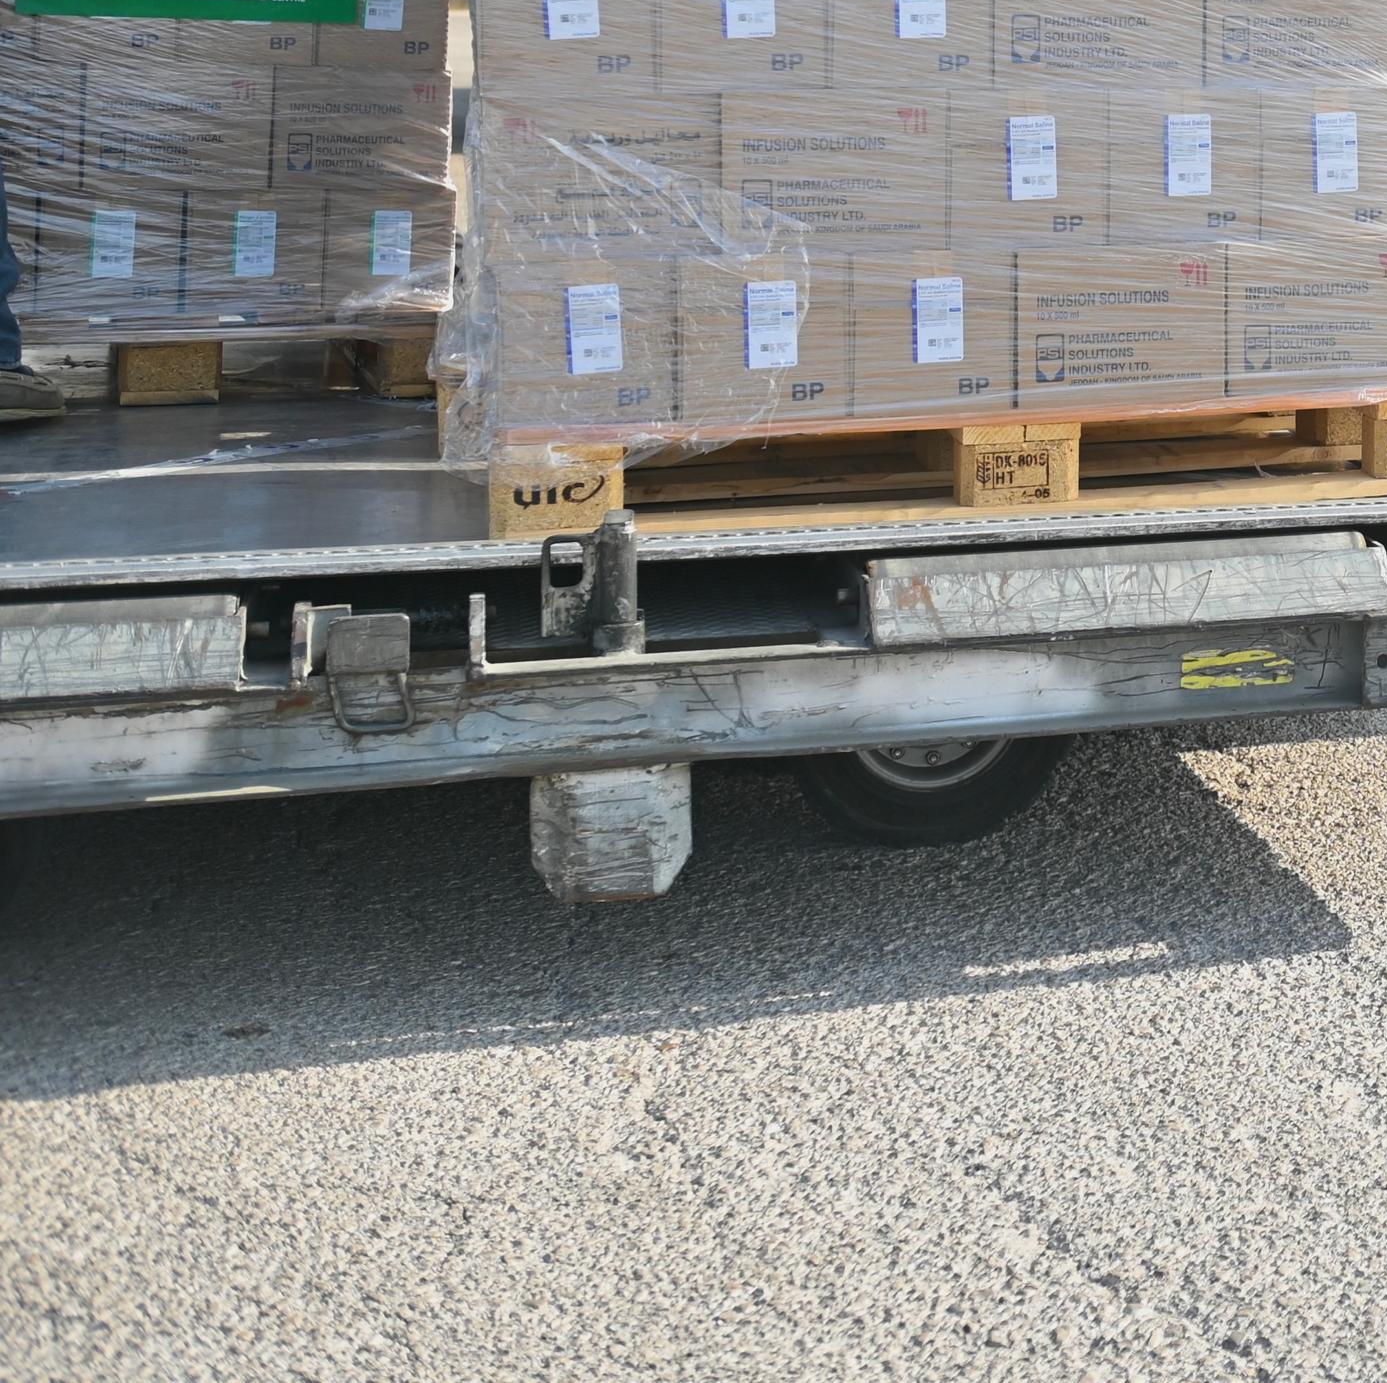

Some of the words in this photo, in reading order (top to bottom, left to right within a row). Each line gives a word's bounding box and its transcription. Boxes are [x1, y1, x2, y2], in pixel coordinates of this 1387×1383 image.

[270, 37, 296, 52] BP
[404, 41, 430, 56] BP
[597, 55, 631, 73] BP
[772, 54, 803, 71] BP
[938, 55, 970, 72] BP
[290, 103, 341, 113] INFUSION
[343, 104, 403, 114] SOLUTIONS
[316, 136, 404, 144] PHARMACEUTICAL
[743, 137, 806, 152] INFUSION
[810, 137, 886, 150] SOLUTIONS
[316, 147, 371, 155] SOLUTIONS
[316, 159, 363, 167] INDUSTRY
[777, 180, 890, 191] PHARMACEUTICAL
[777, 195, 847, 207] SOLUTIONS
[843, 211, 865, 221] LTD.
[1207, 212, 1236, 228] BP
[1053, 216, 1083, 232] BP
[1245, 284, 1300, 300] INFUSION
[1304, 281, 1368, 296] SOLUTIONS
[1037, 293, 1095, 308] INFUSION
[1100, 290, 1168, 305] SOLUTIONS
[1274, 321, 1372, 335] PHARMACEUTICAL
[1069, 331, 1172, 344] PHARMACEUTICAL
[1275, 338, 1336, 349] SOLUTIONS
[1069, 348, 1133, 360] SOLUTIONS
[1275, 353, 1328, 364] INDUSTRY
[1331, 351, 1352, 361] LTD.
[1069, 363, 1125, 375] INDUSTRY
[1129, 362, 1151, 372] LTD.
[791, 383, 825, 401] BP
[958, 377, 989, 395] BP
[618, 388, 651, 406] BP
[996, 471, 1015, 484] HT
